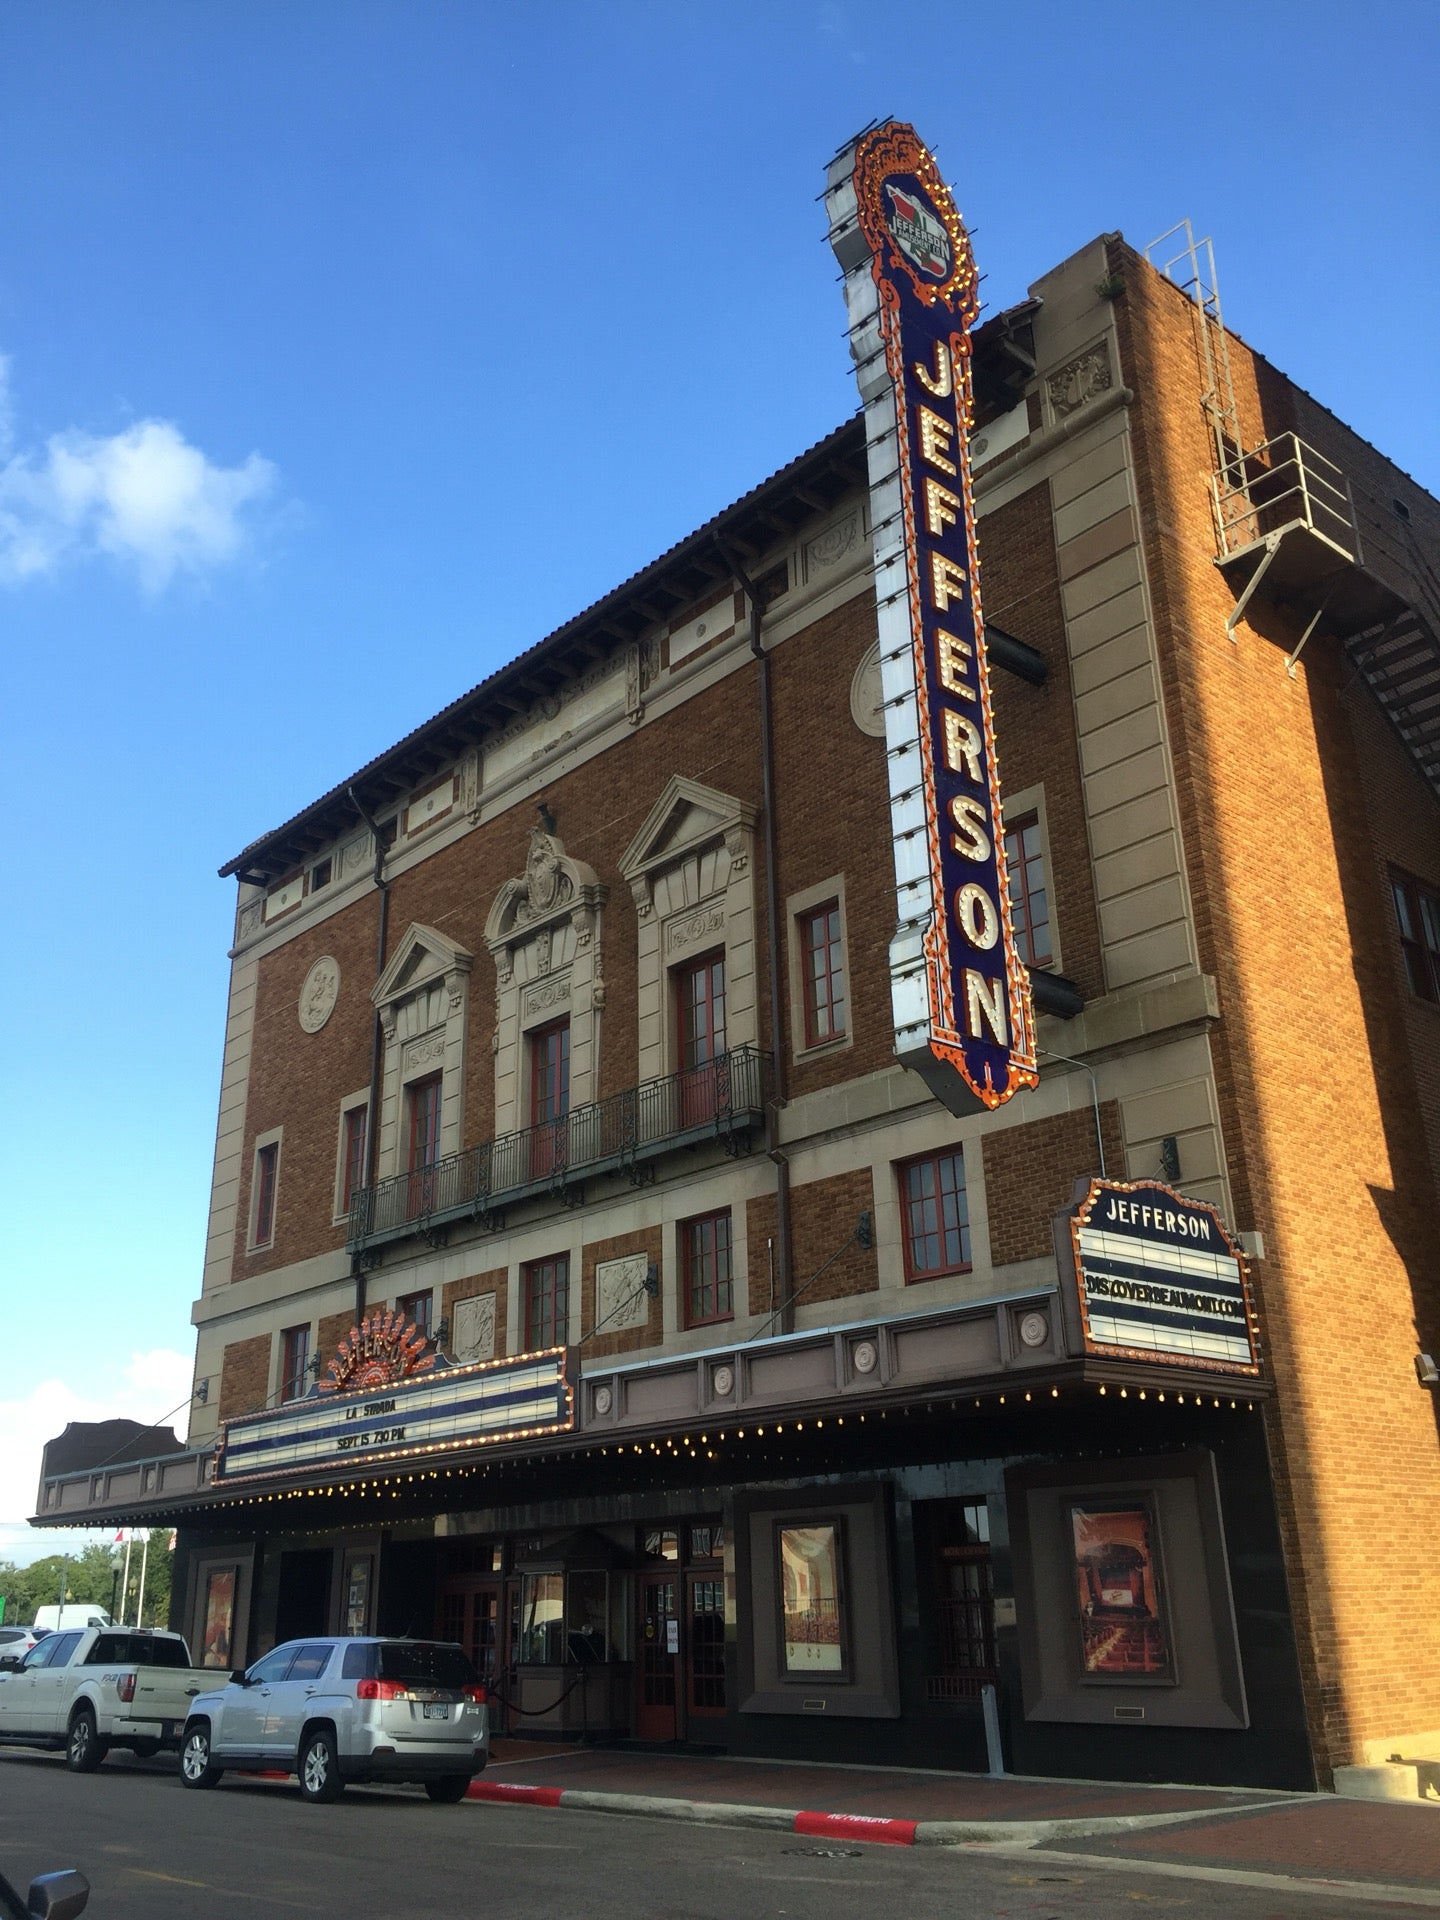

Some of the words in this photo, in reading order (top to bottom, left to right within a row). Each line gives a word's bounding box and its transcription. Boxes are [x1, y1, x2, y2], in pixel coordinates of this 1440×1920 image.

[888, 215, 950, 261] JEFFERSON
[914, 340, 1010, 1050] JEFFERSON
[1106, 1198, 1211, 1241] JEFFERSON
[346, 1407, 357, 1420] LA
[364, 1399, 396, 1416] STRADA
[337, 1435, 360, 1450] SEPT
[361, 1432, 370, 1446] 15
[391, 1426, 406, 1440] PM
